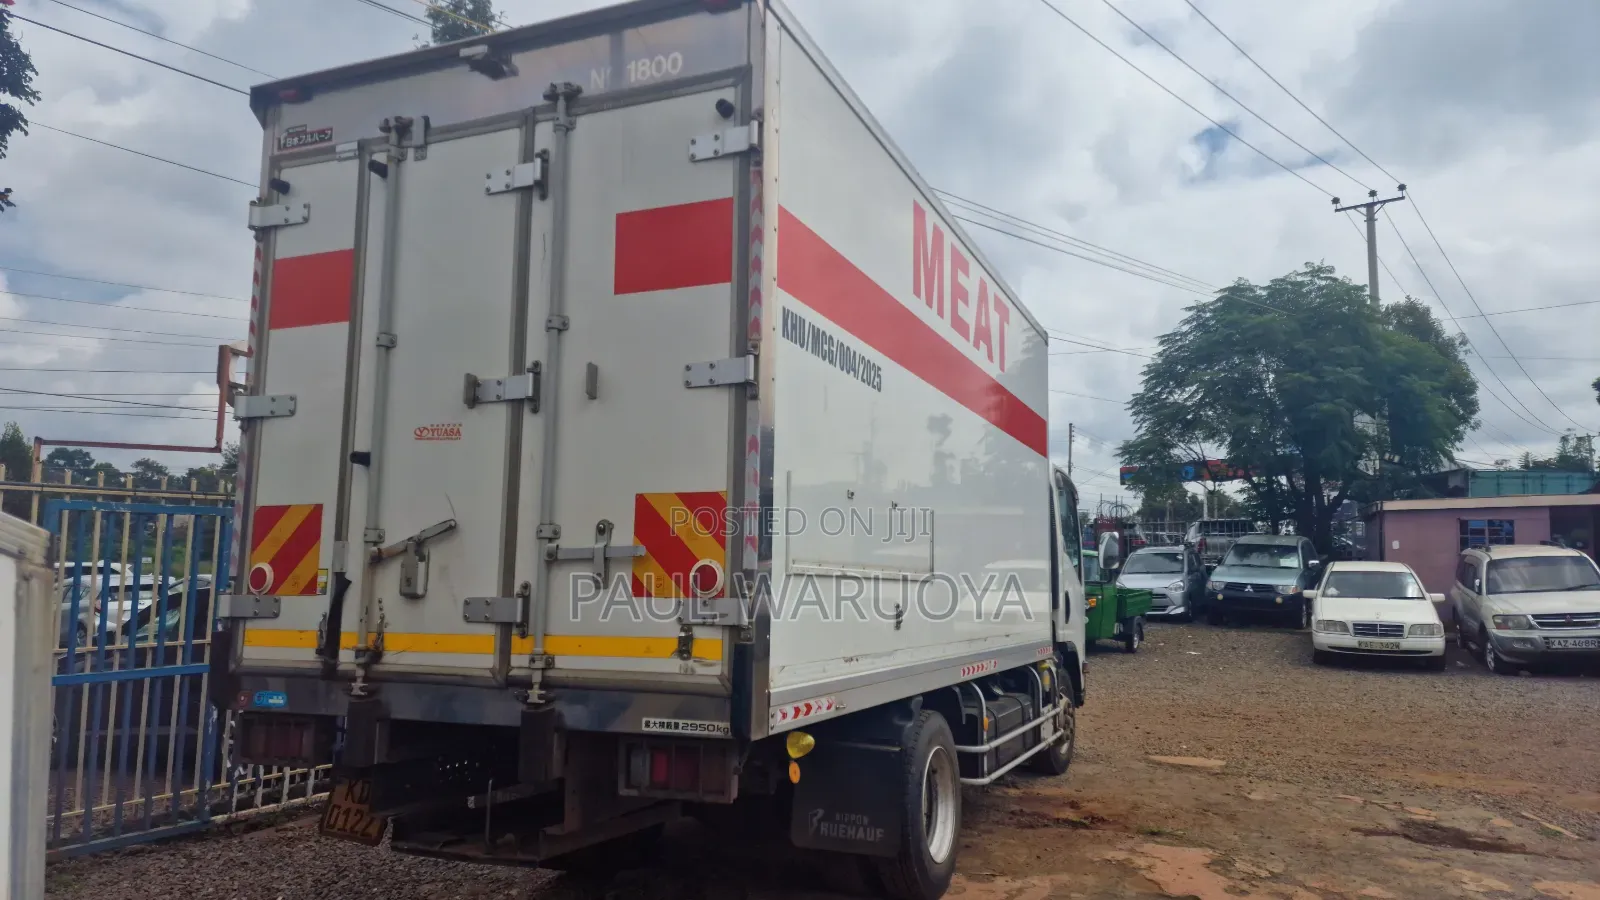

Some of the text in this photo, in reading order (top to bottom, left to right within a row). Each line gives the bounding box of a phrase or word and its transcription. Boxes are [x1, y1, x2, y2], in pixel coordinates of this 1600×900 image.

[626, 51, 683, 83] 1800
[913, 198, 1010, 373] MEAT
[782, 305, 882, 393] KHU/MCG/004/2025
[430, 427, 462, 437] YUASA
[681, 722, 729, 734] 2950kg
[835, 812, 870, 826] NIPPON
